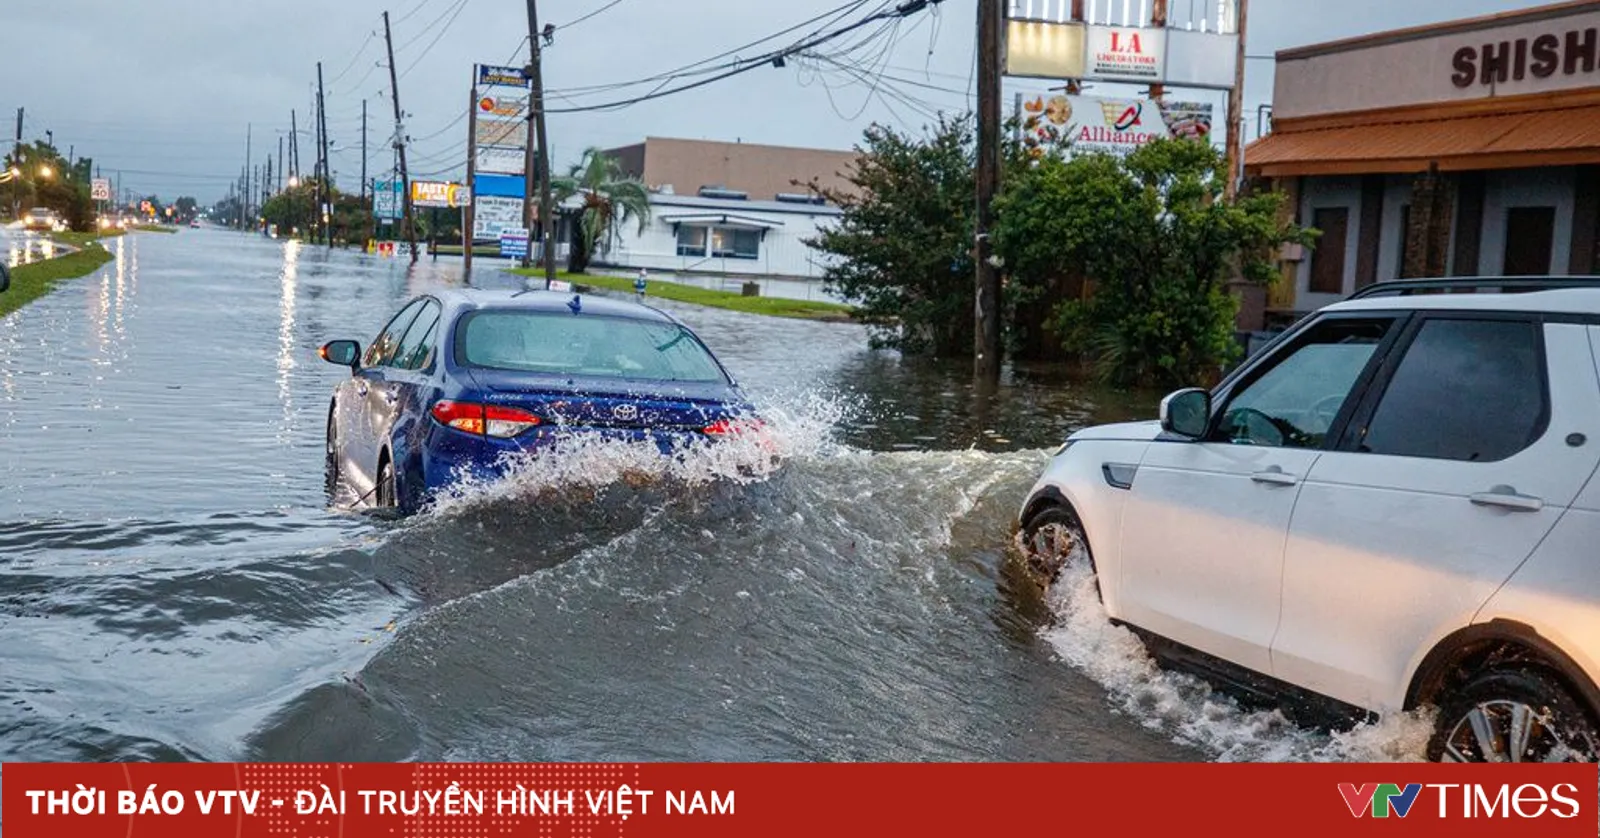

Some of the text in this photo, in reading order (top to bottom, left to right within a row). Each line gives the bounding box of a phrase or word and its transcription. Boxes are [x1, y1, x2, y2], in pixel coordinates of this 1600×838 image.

[1111, 31, 1141, 53] LA
[1096, 53, 1156, 64] LIQUIDATORS
[1451, 28, 1600, 88] SHISH
[1078, 125, 1155, 144] Alliance
[91, 189, 107, 198] 40
